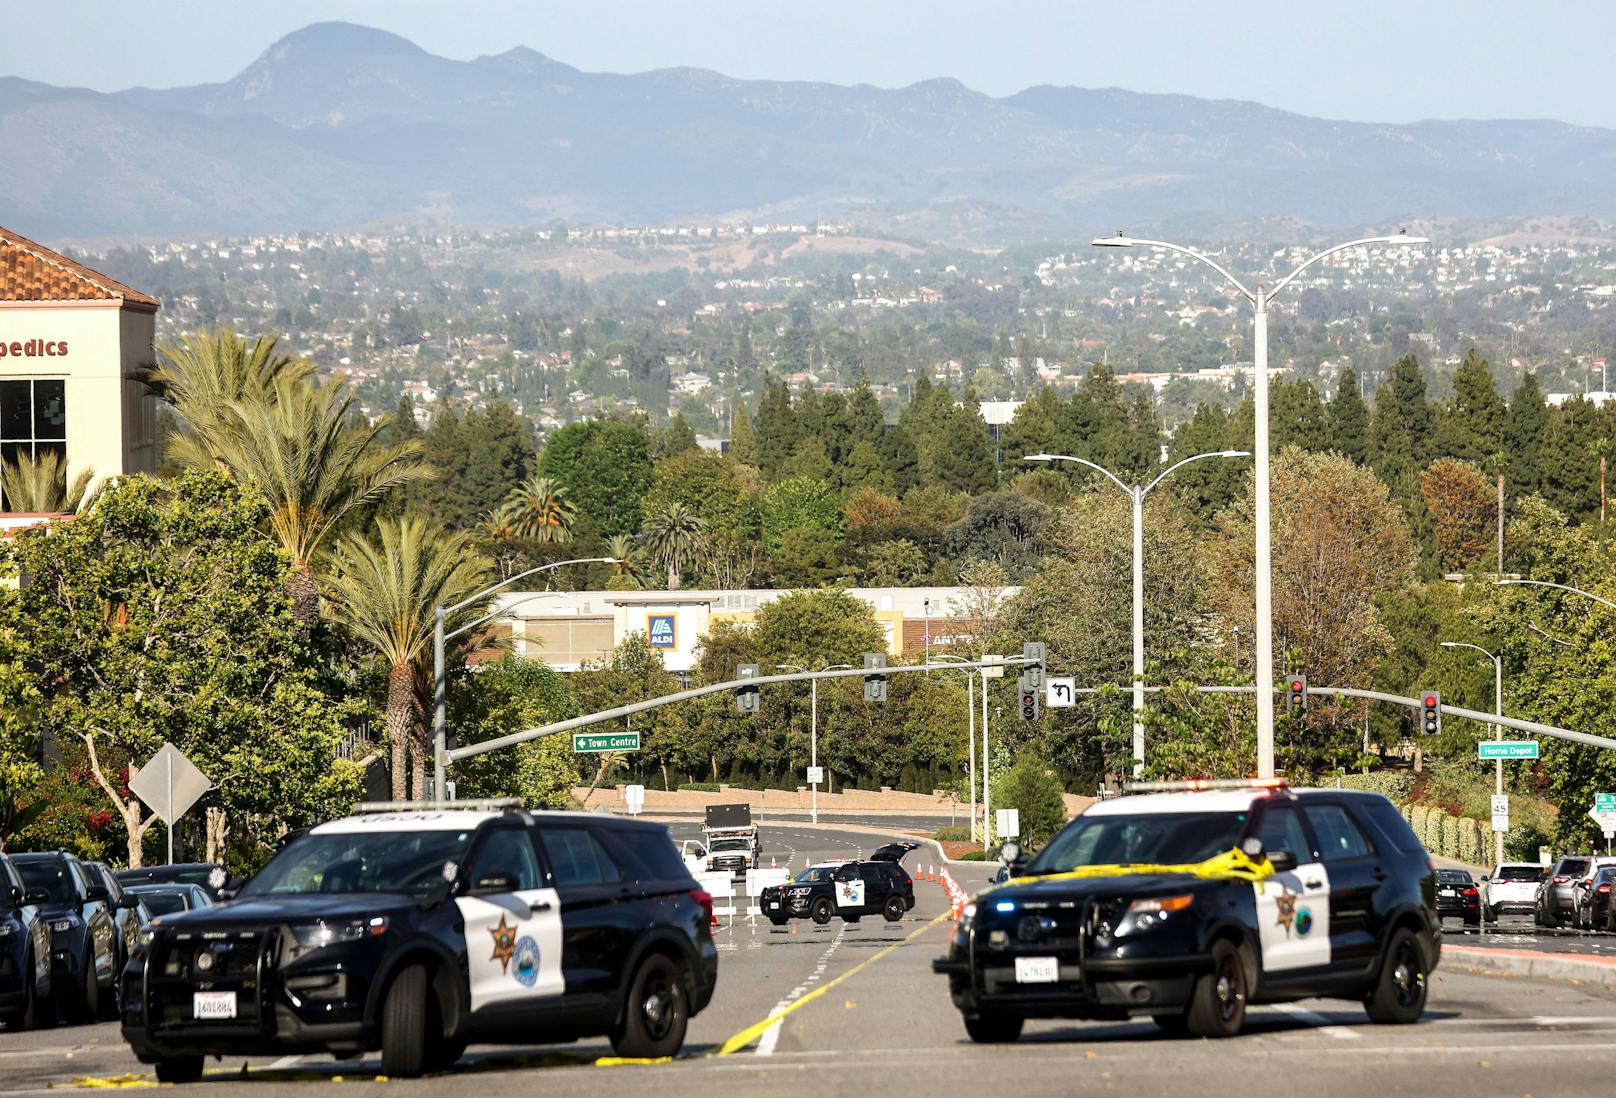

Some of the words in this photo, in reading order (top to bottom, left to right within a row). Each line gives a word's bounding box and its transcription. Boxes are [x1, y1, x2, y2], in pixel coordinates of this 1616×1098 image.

[651, 635, 673, 644] ALDI
[588, 738, 607, 747] Town
[610, 737, 637, 747] Centre
[1484, 747, 1508, 755] Home
[1509, 746, 1533, 756] Depot
[1493, 804, 1506, 813] 45
